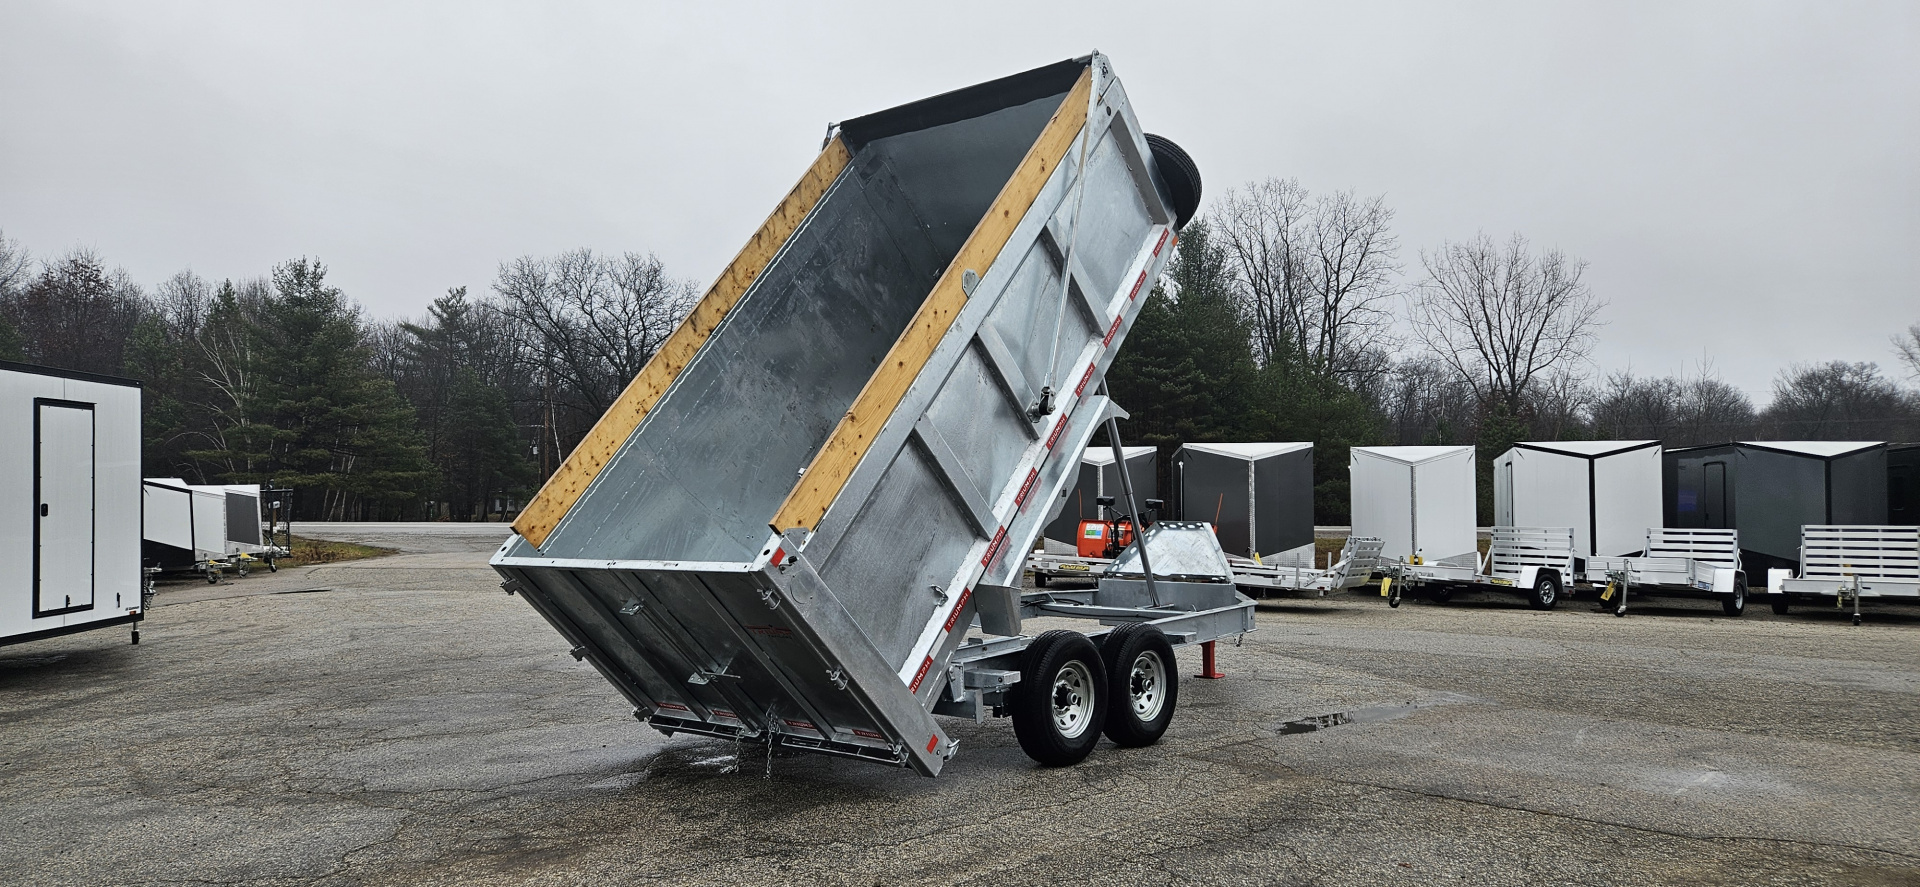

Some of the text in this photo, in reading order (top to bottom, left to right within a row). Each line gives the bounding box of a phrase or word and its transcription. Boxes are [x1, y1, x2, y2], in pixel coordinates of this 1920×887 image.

[1131, 273, 1145, 299] TRIUMPH
[1106, 318, 1120, 345] TRIUMPH
[1076, 366, 1094, 394] TRIUMPH
[1048, 417, 1066, 447] TRIUMPH
[1017, 472, 1036, 502] TRIUMPH
[983, 530, 1004, 563] TRIUMPH
[949, 593, 969, 628] TRIUMPH
[910, 661, 931, 692] RIUMPH
